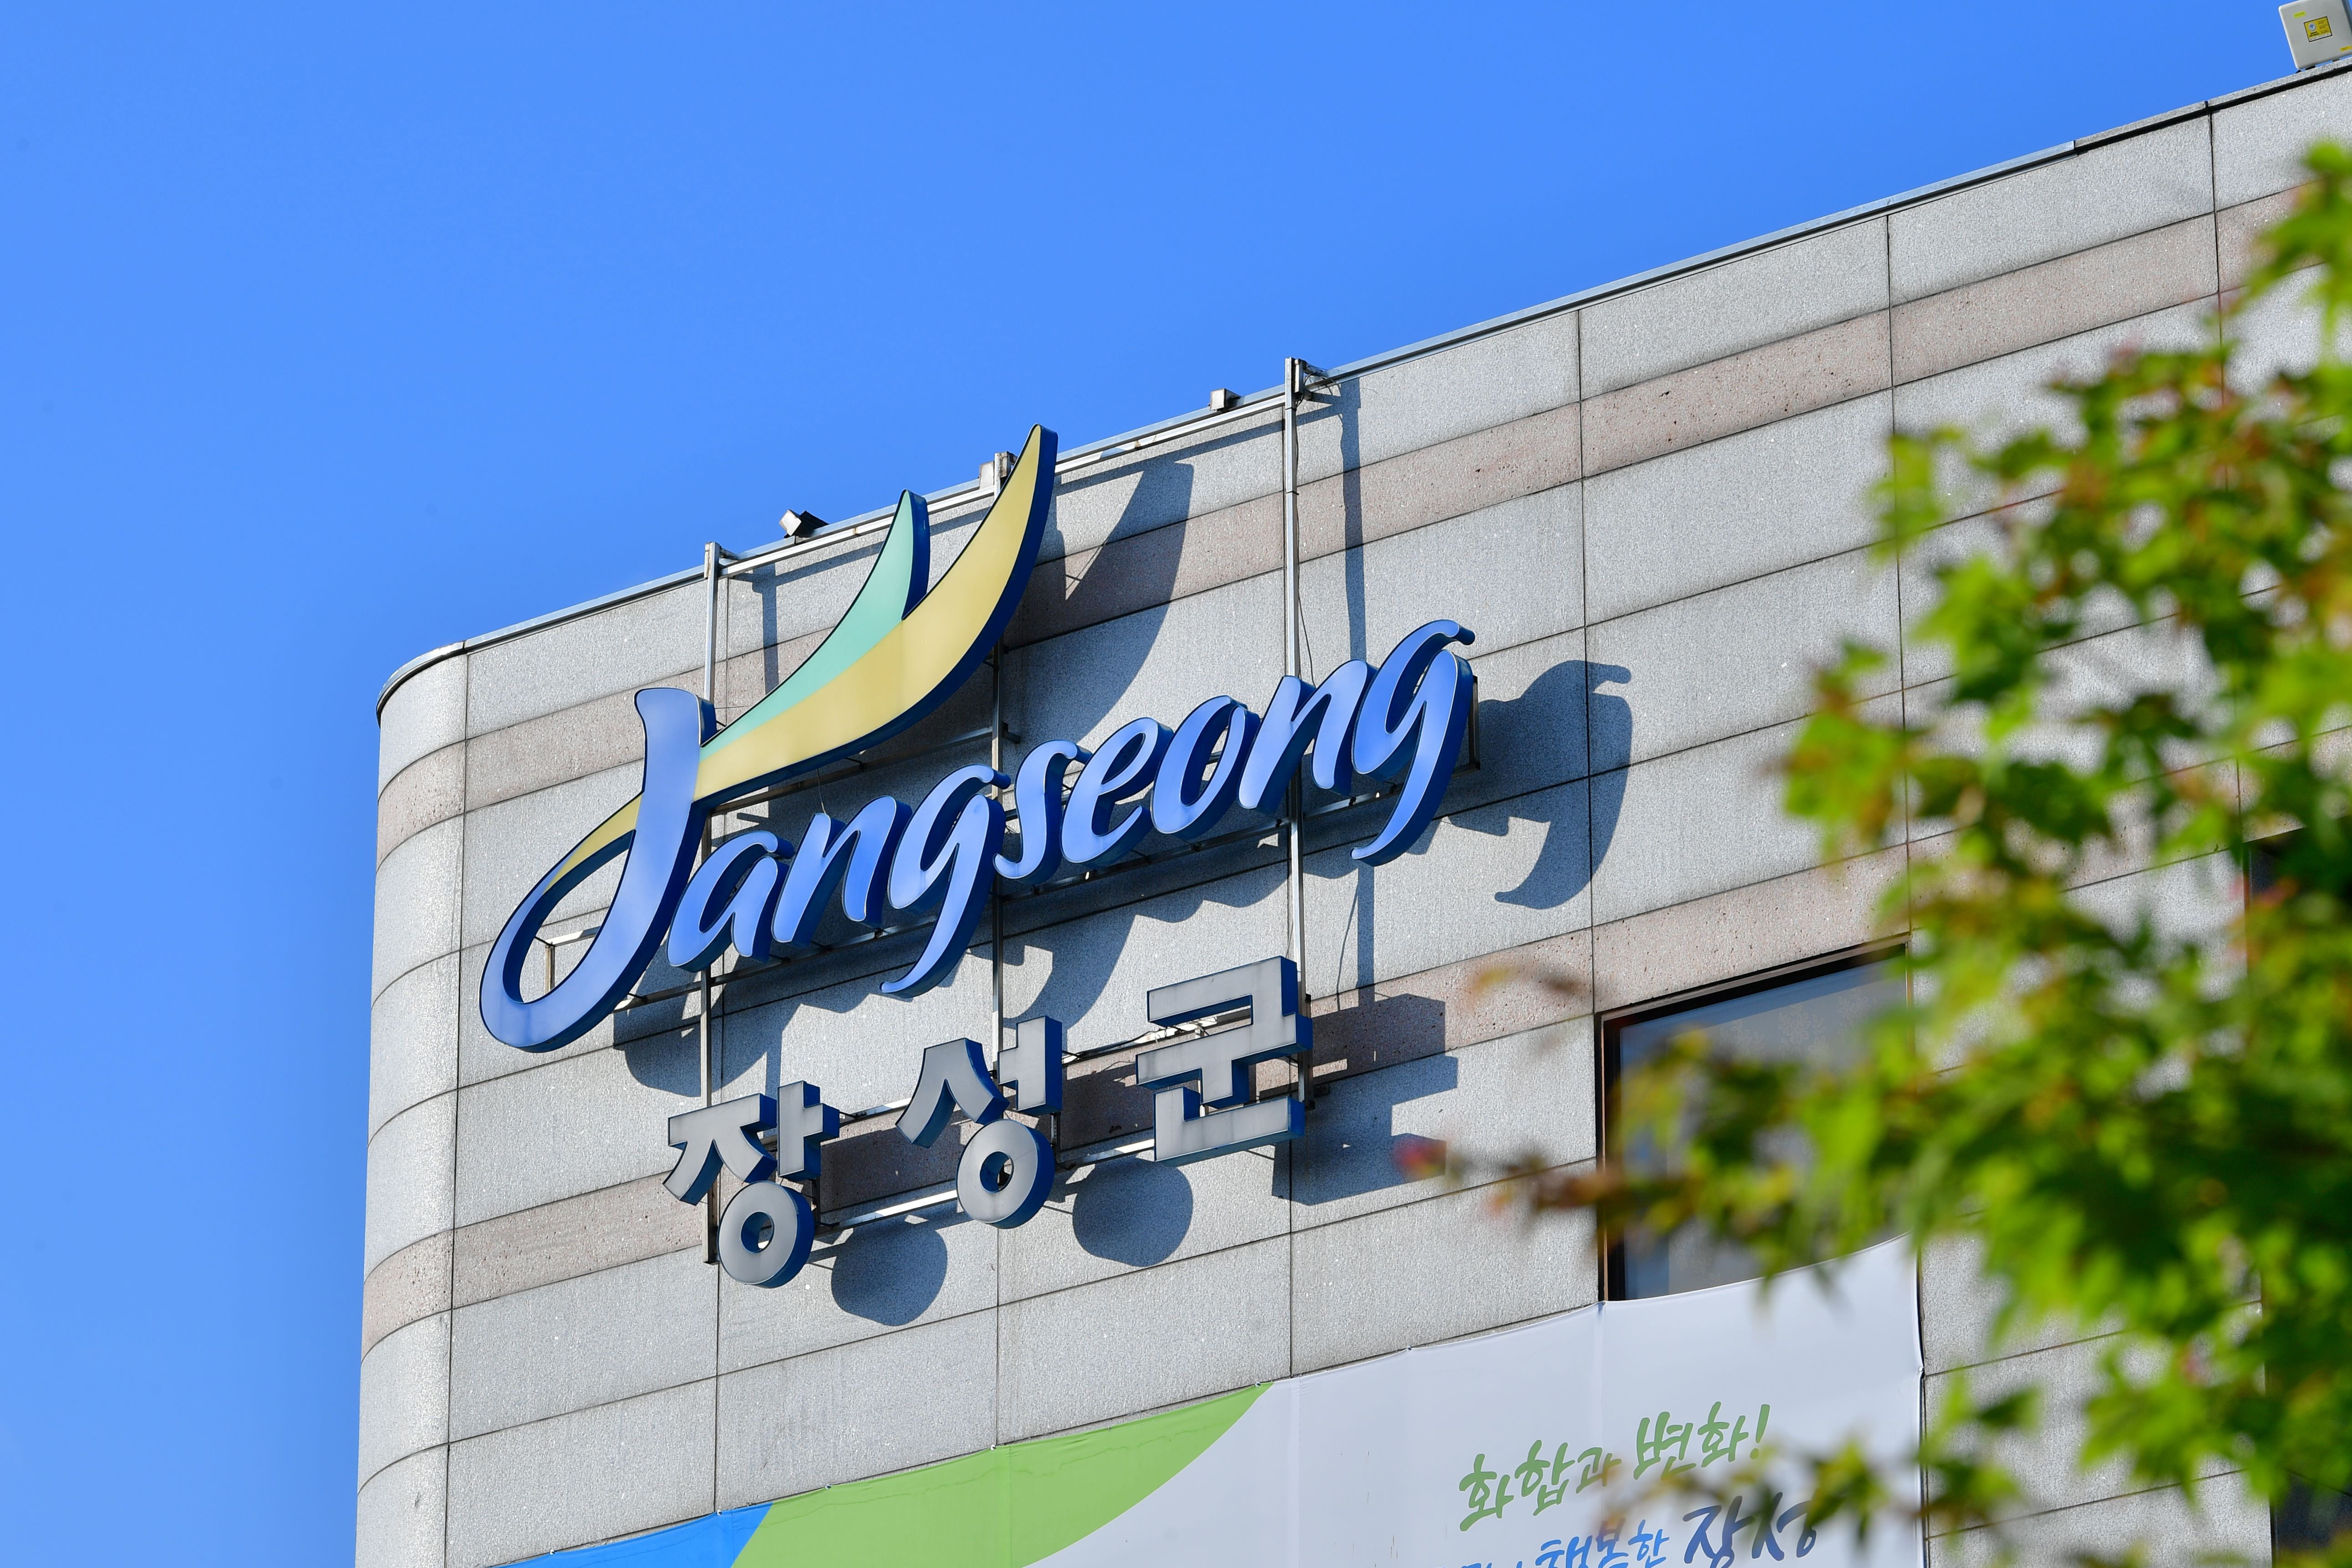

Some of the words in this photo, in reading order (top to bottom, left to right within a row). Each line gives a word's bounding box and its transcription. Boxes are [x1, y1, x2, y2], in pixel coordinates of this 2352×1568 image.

[479, 619, 1475, 1053] Jangseong
[662, 955, 1313, 1288] 장성군
[1459, 1439, 1622, 1532] 화합과
[1634, 1401, 1771, 1480] 변화!
